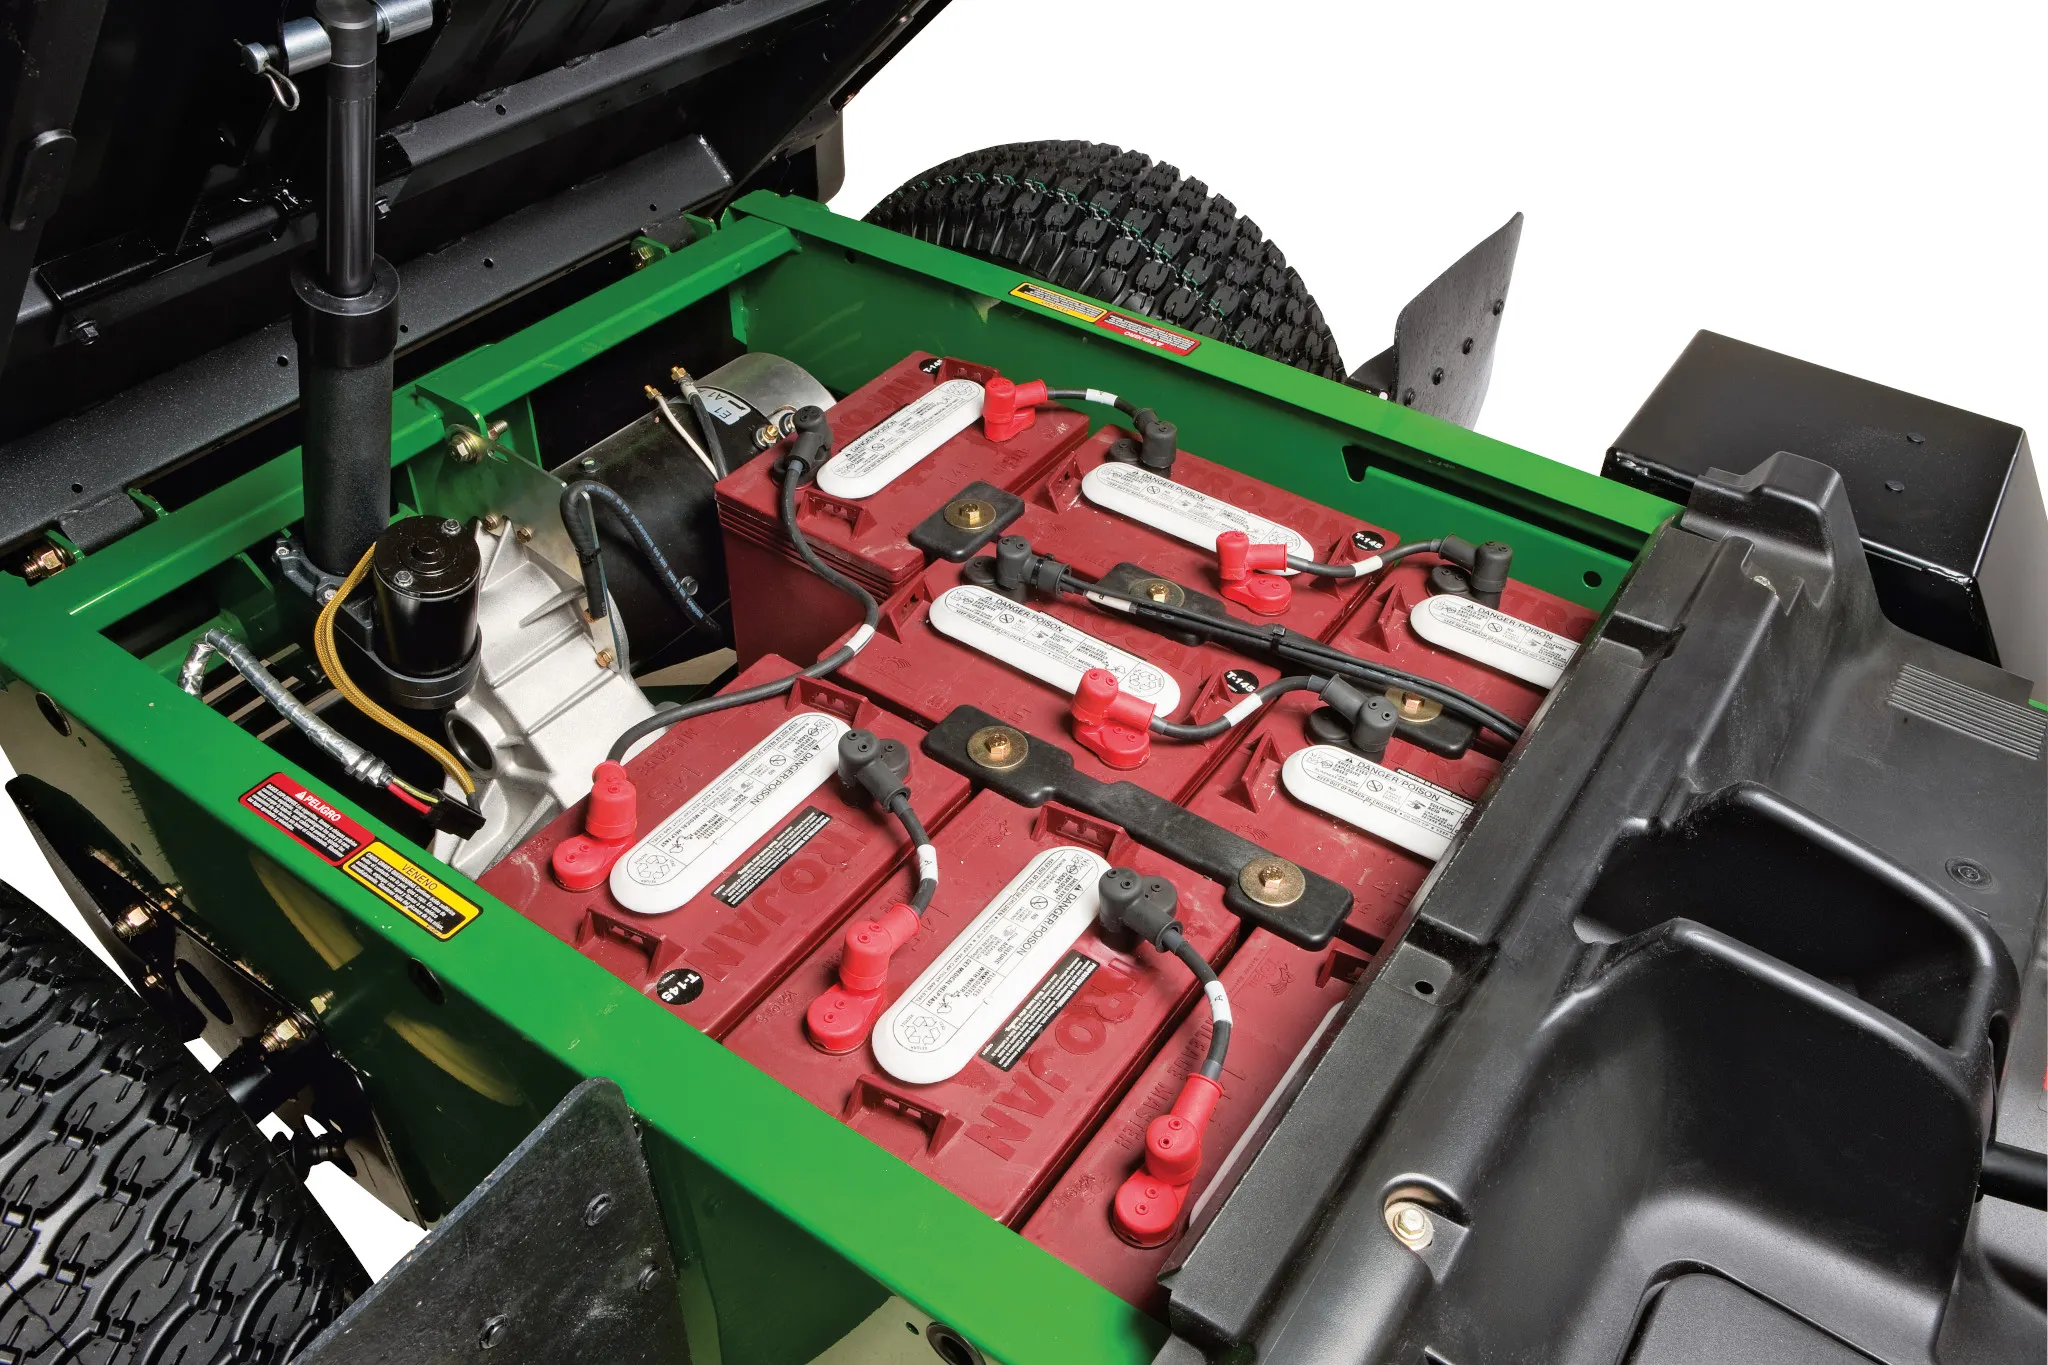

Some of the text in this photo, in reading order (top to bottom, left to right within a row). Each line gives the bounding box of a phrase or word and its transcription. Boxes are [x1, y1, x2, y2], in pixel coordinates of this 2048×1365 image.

[714, 406, 732, 420] E1
[1355, 532, 1383, 549] T-145
[998, 598, 1062, 632] DANGER/POISON
[1477, 606, 1553, 640] DANGER/POISON
[1226, 670, 1256, 693] T-145
[749, 751, 813, 805] DANGER/POISON
[1360, 758, 1441, 801] DANGER/POISON
[302, 794, 342, 822] PELIGRO
[1429, 802, 1454, 816] SULFURIC
[659, 806, 708, 847] GET MEDICAL HELP FAST
[1036, 866, 1046, 875] OUT
[1043, 858, 1054, 868] KEEP
[400, 863, 438, 890] VENENO
[1019, 879, 1034, 892] REACH
[1052, 874, 1073, 894] EXPLOSIVE
[1054, 871, 1067, 884] GASES
[1055, 877, 1078, 900] SHIELD EYES
[683, 820, 866, 982] TROJAN
[997, 896, 1017, 916] CHILDREN
[1016, 892, 1076, 956] DANGER/POISON
[994, 944, 1013, 964] SULFURIC
[997, 941, 1008, 952] ACID
[659, 970, 700, 1002] T-145
[925, 958, 971, 1006] GET MEDICAL HELP FAST
[959, 966, 985, 992] WITH WATER
[963, 968, 990, 997] IMMEDIATELY
[971, 972, 996, 997] FLUSH EYES
[966, 958, 1145, 1161] TROJAN
